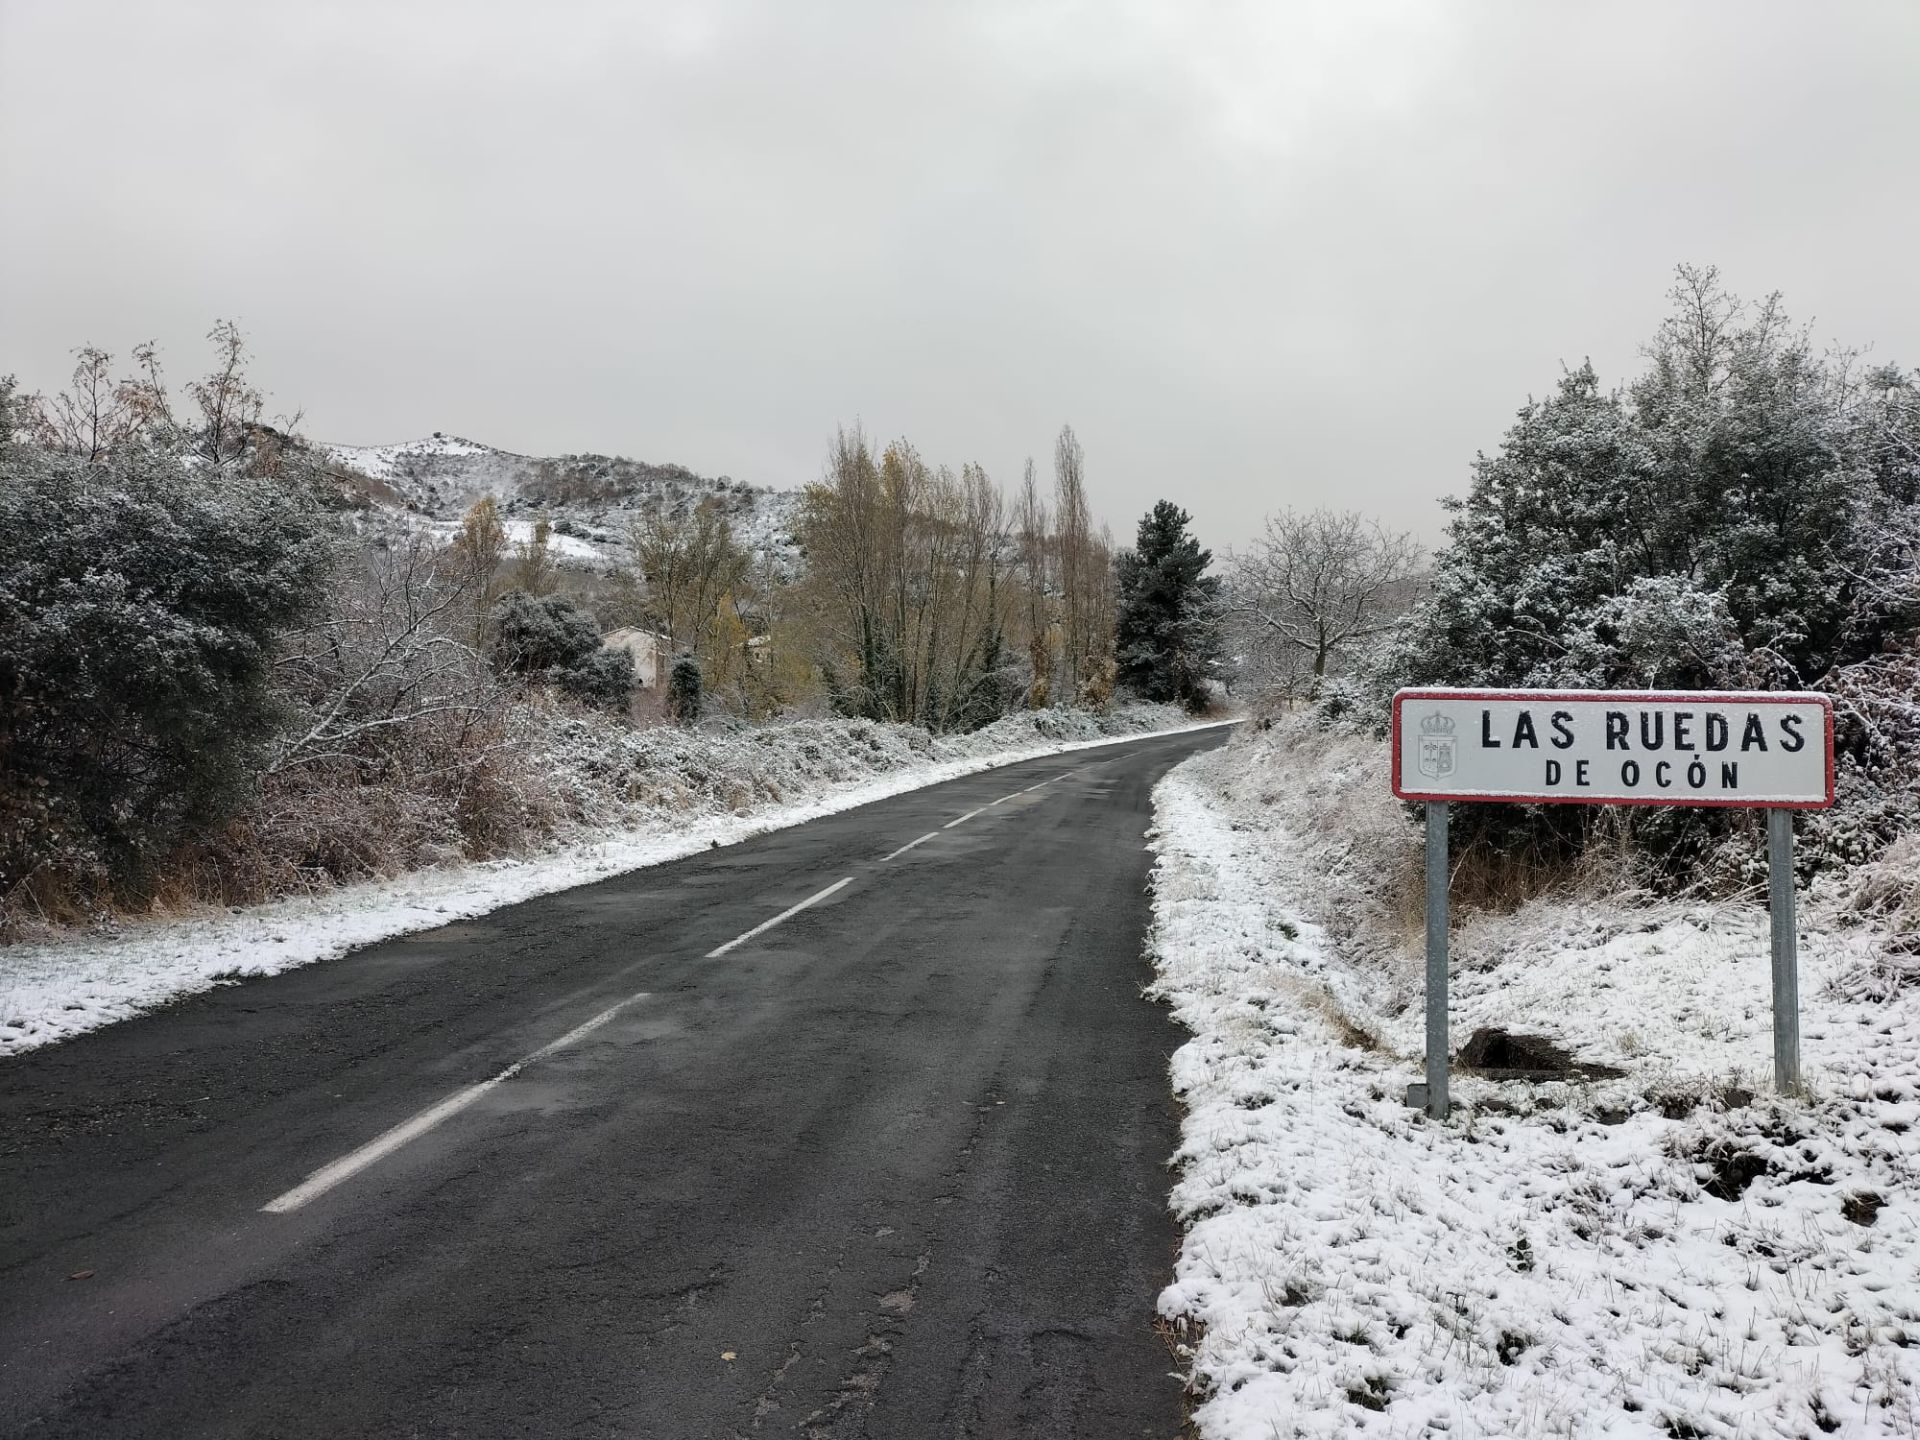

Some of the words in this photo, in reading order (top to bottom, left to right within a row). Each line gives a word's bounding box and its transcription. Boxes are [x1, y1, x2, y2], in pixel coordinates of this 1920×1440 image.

[1482, 710, 1574, 749] LAS
[1606, 712, 1804, 752] RUEDAS
[1546, 760, 1590, 786] DE
[1621, 754, 1737, 788] OCÓN
